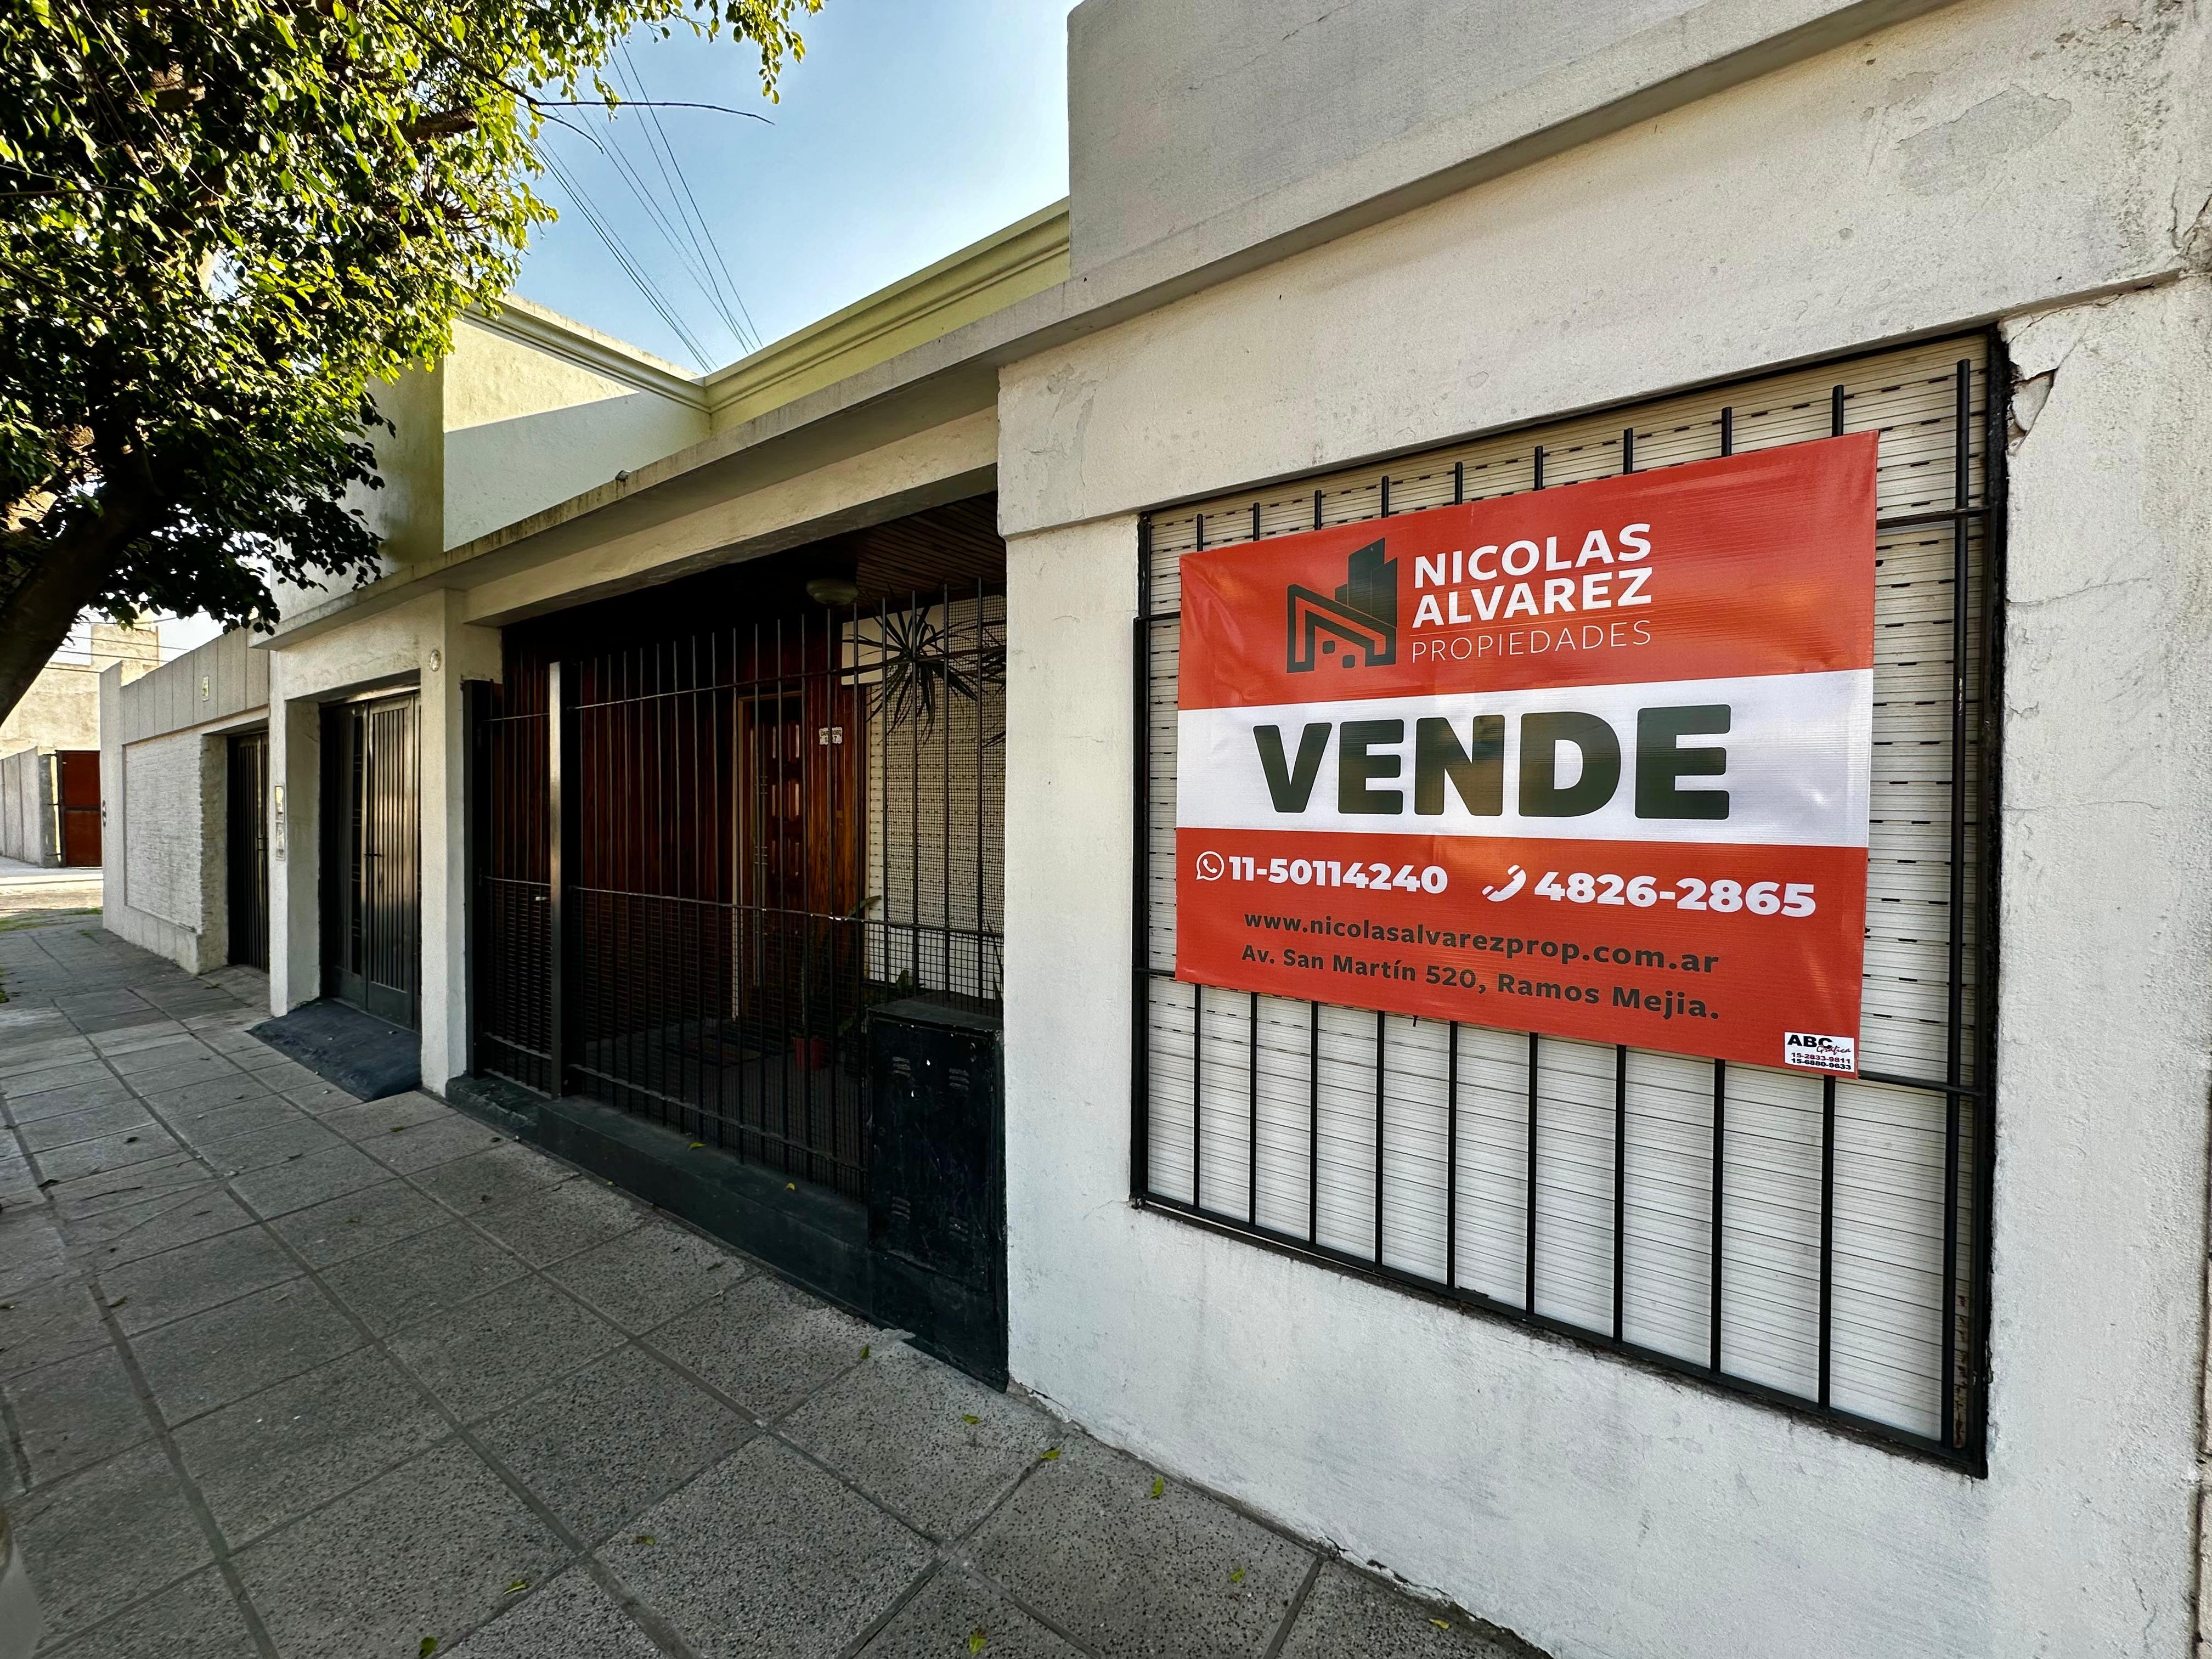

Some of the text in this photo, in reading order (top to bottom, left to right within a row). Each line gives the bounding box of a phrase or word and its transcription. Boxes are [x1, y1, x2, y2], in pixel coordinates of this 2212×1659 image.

[1414, 523, 1651, 589] NICOLAS
[1412, 567, 1653, 629] ALVAREZ
[1412, 620, 1651, 663] PROPIEDADES
[1253, 704, 1731, 820] VENDE
[1228, 856, 1816, 918] 11-50114240 4826-2865
[1244, 913, 1719, 973] www.nicolasalvarezprop.com.ar
[1242, 944, 1719, 1020] Av. San Martín 520, Ramos Mejia.
[1787, 1034, 1833, 1048] ABC
[1791, 1052, 1850, 1064] 15-2833-9811
